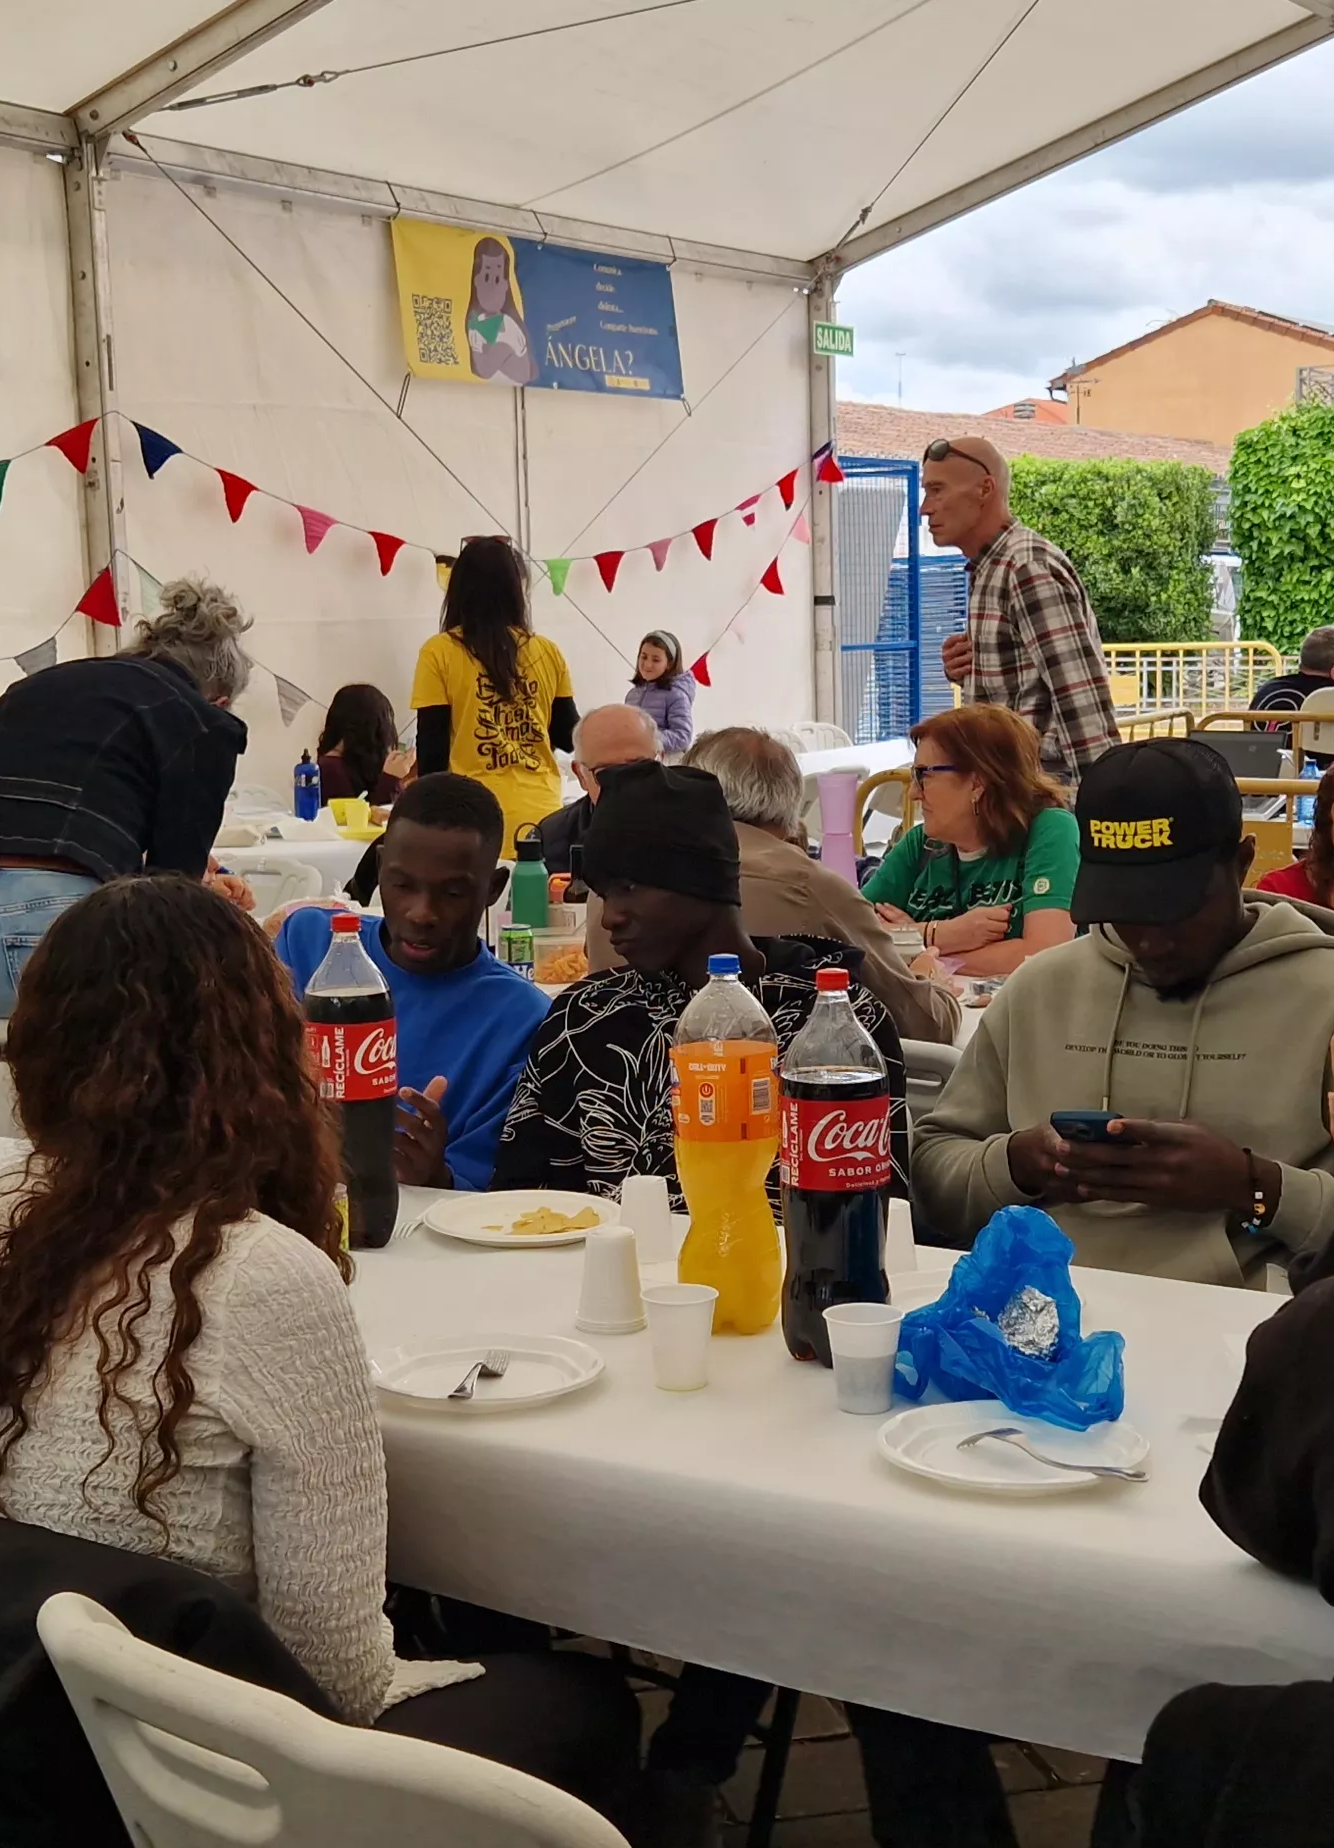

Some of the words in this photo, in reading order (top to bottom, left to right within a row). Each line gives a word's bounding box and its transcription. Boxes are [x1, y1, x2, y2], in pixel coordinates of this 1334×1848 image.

[817, 327, 852, 353] SALIDA
[545, 335, 634, 376] ÁNGELA?
[1089, 818, 1171, 837] POWER
[1091, 830, 1174, 849] TRUCK
[828, 1165, 872, 1177] SABOR
